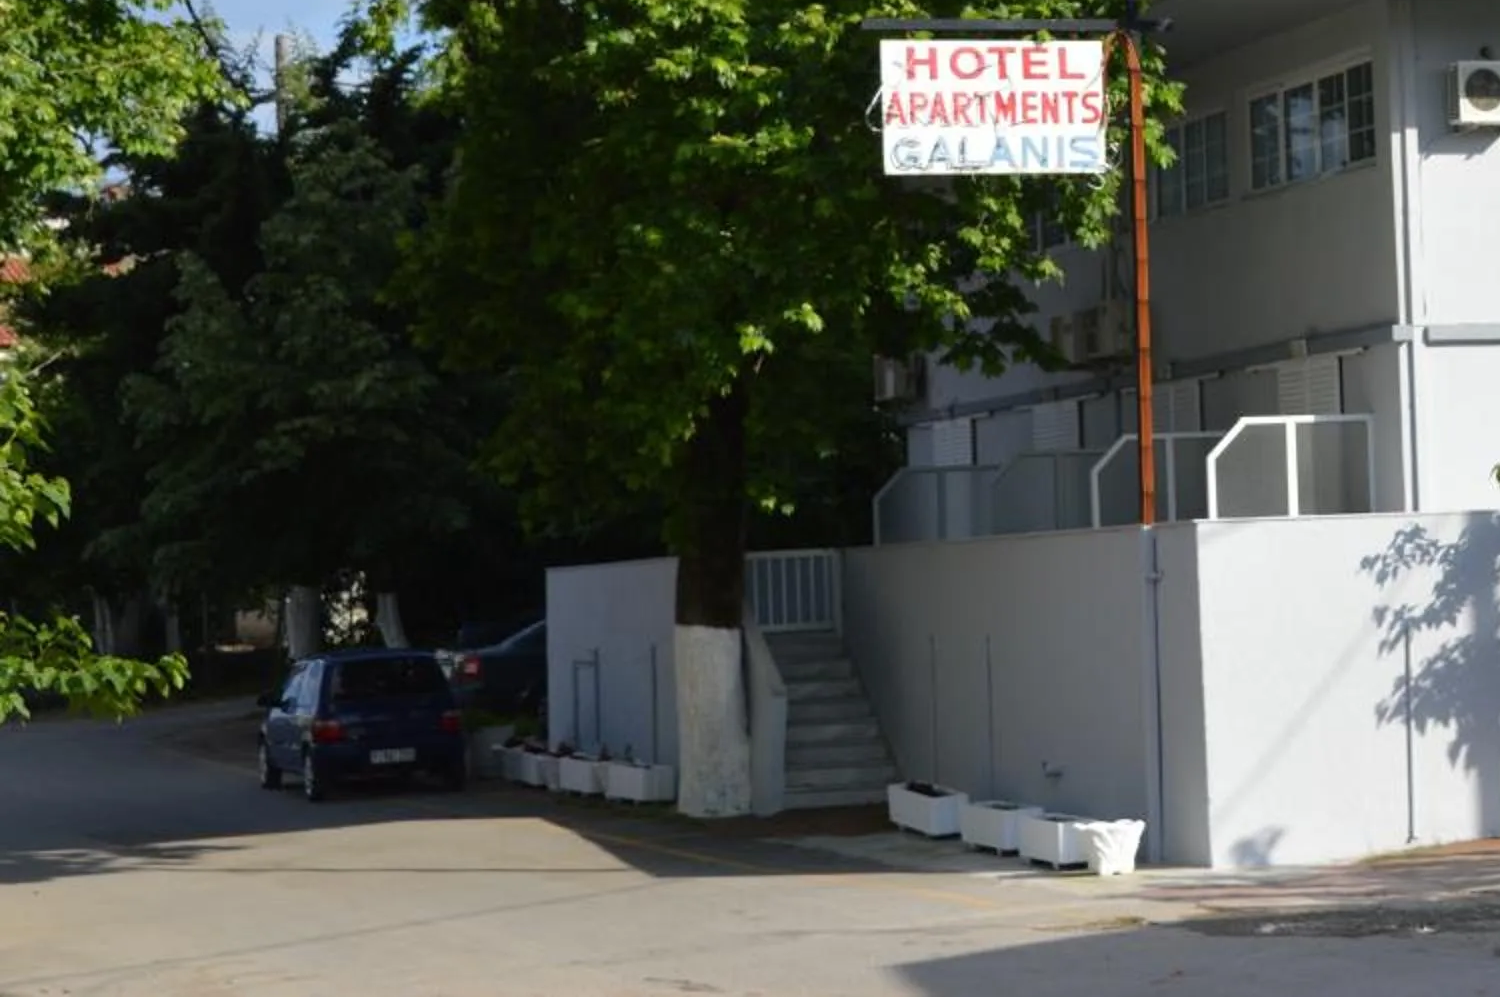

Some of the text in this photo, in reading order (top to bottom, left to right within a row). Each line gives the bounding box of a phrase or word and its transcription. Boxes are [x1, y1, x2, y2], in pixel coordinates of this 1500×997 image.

[905, 46, 1085, 81] HOTEL
[885, 90, 1101, 125] APARTMENTS
[892, 135, 1098, 171] GALANIS
